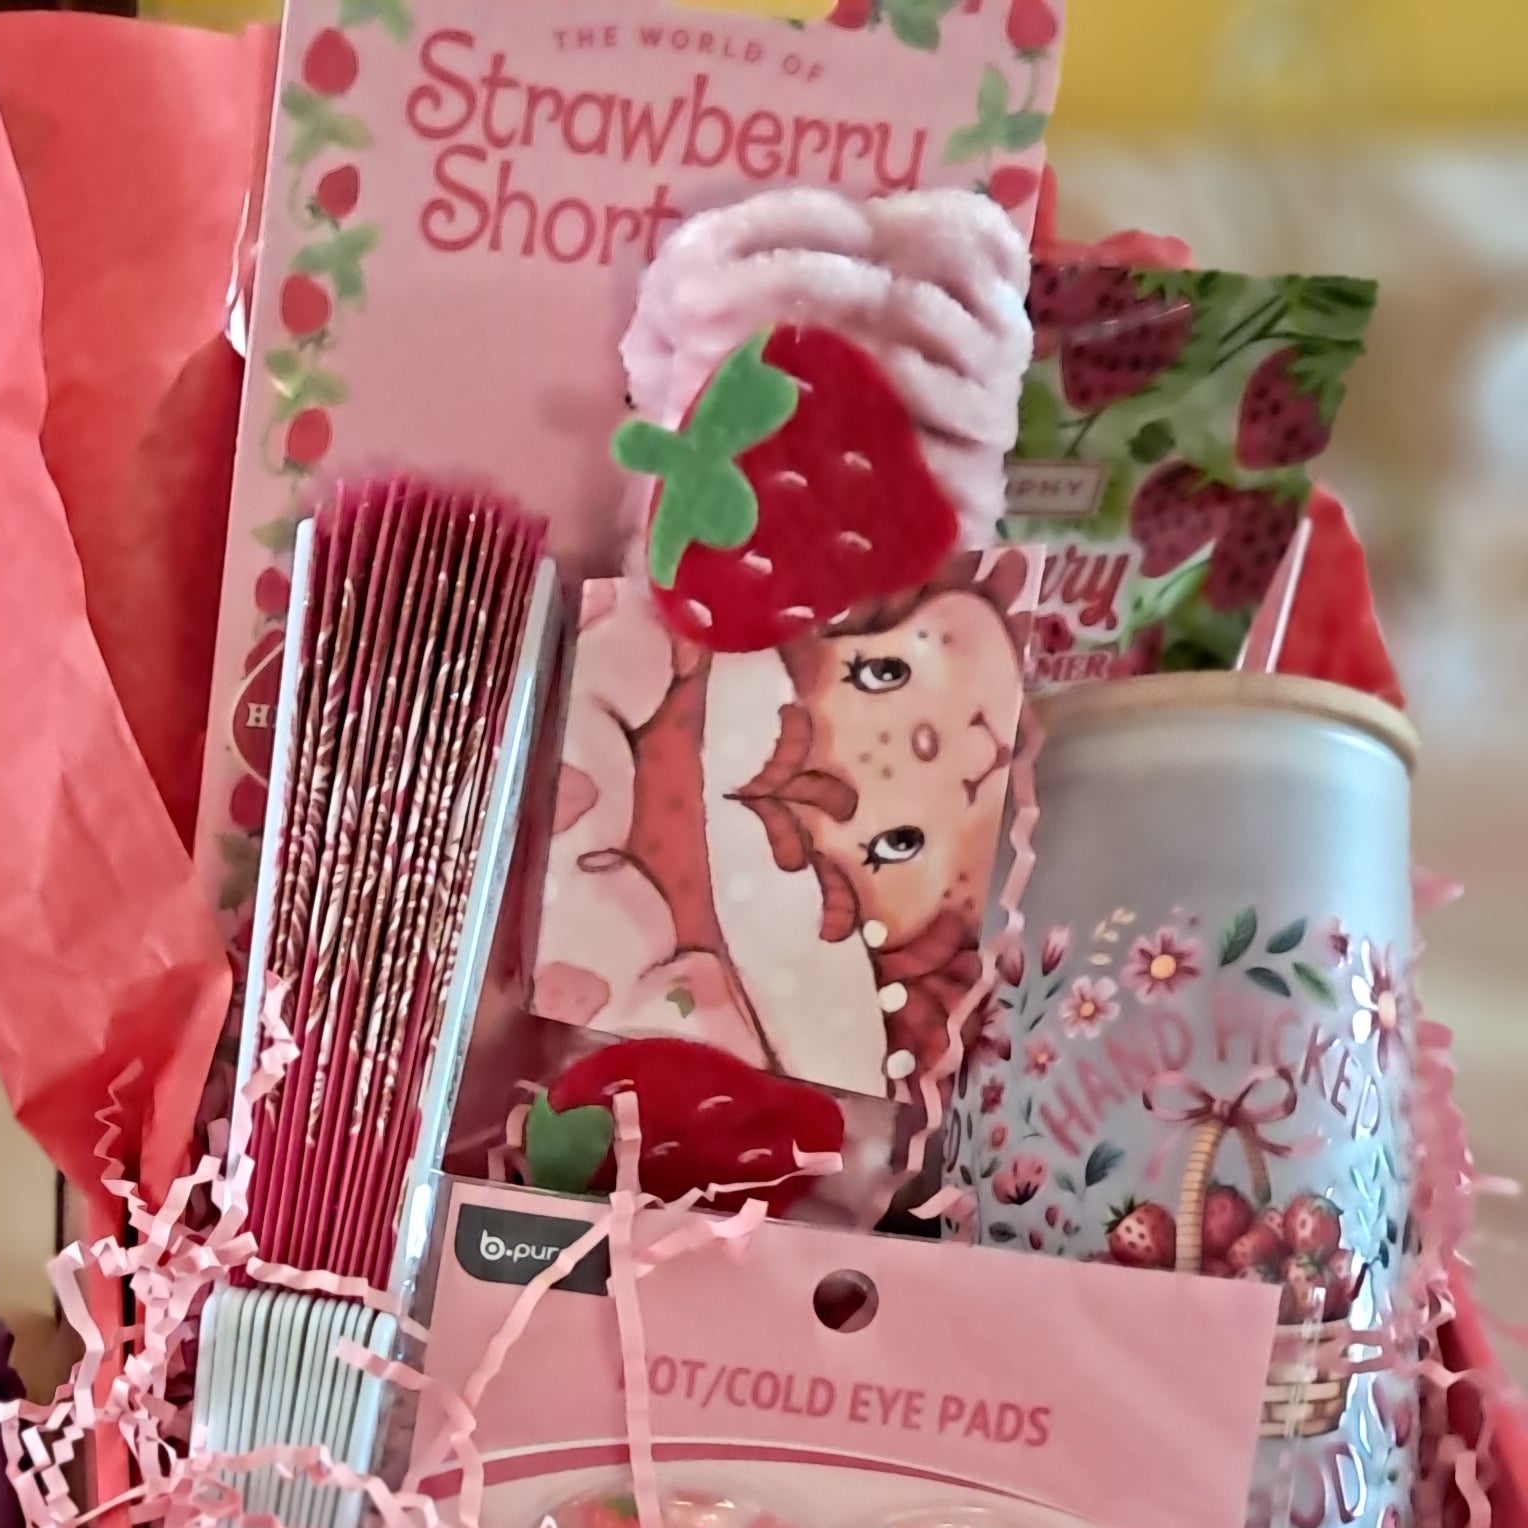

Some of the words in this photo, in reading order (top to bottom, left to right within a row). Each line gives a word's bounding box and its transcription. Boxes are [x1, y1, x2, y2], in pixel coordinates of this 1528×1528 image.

[554, 26, 618, 49] THE
[640, 27, 763, 62] WORLD
[783, 54, 824, 82] OF
[406, 28, 928, 190] Strawberry
[419, 144, 682, 267] Short
[1012, 480, 1083, 496] PHY
[1040, 1008, 1193, 1156] HAND
[1210, 1003, 1382, 1141] PICKED
[480, 1229, 561, 1262] b.pur
[618, 1353, 836, 1418] OT/COLD
[849, 1384, 925, 1430] EYE
[938, 1394, 1052, 1447] PADS
